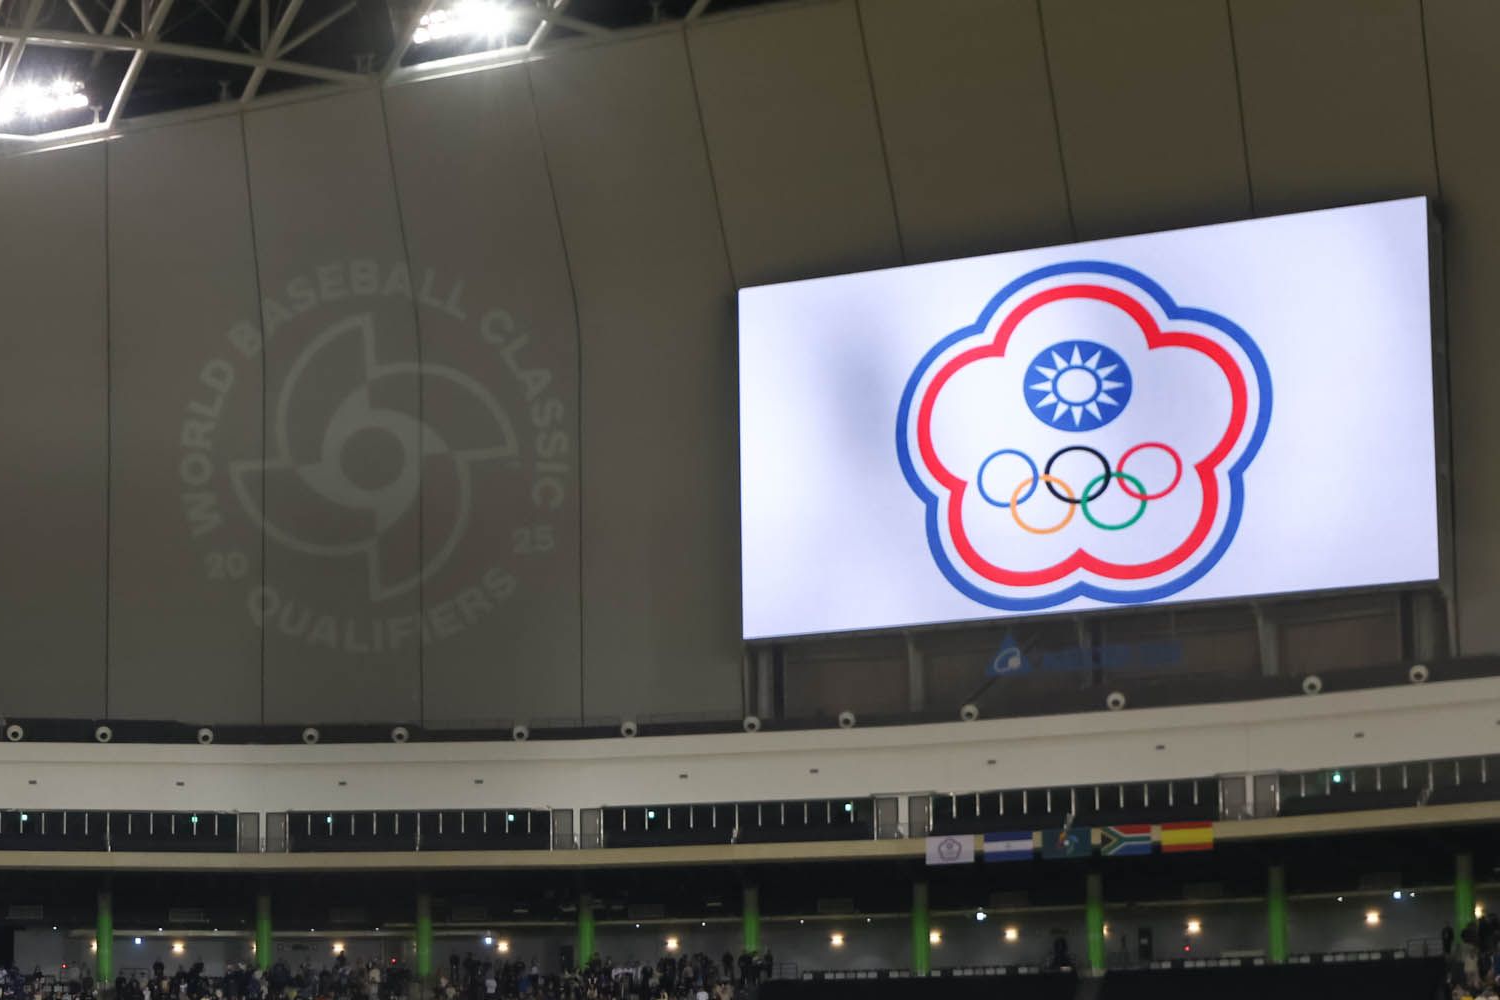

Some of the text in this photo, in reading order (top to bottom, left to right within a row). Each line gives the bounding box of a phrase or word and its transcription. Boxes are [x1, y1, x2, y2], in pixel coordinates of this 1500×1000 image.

[180, 259, 569, 537] WORLD BASEBALL CLASSIC
[204, 552, 248, 580] 20
[246, 566, 517, 654] QUALIFIERS
